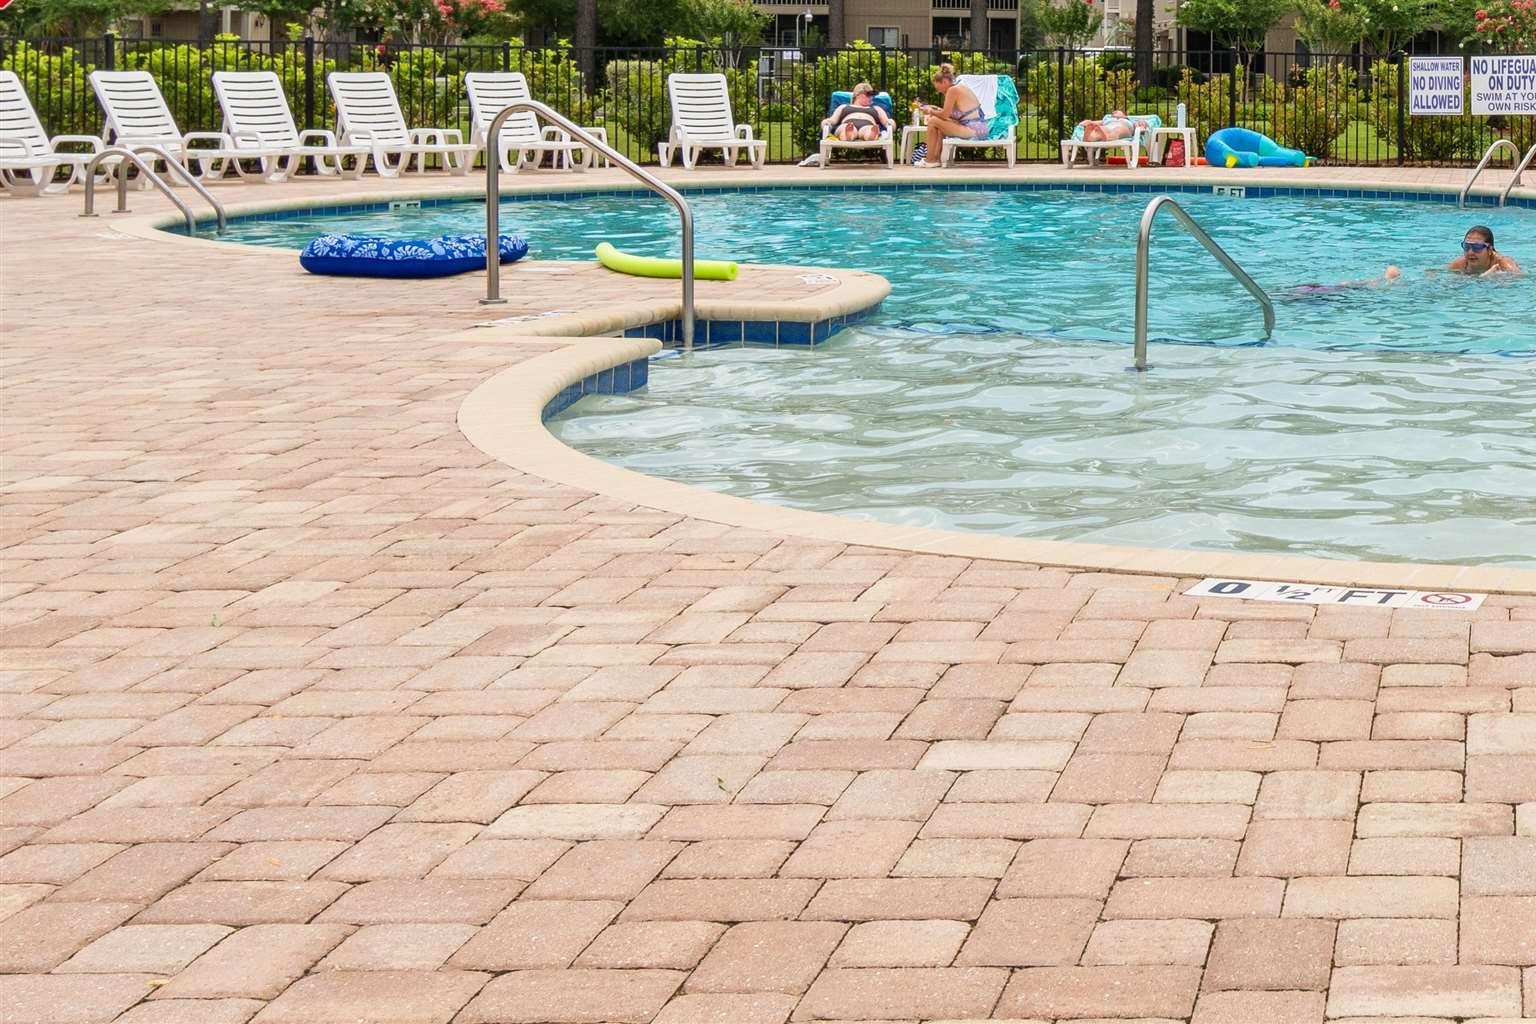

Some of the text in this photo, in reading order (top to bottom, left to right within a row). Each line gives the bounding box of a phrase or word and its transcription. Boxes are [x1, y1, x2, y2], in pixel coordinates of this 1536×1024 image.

[1413, 62, 1460, 71] SHALLOW WATER
[1473, 59, 1488, 74] NO
[1413, 76, 1460, 90] NO DIVING
[1489, 76, 1536, 90] ON DUTY
[1413, 95, 1460, 109] ALLOWED
[1477, 92, 1502, 102] SWIM
[1505, 92, 1518, 101] AT
[1488, 103, 1536, 112] OWN RISK
[1338, 590, 1407, 604] FT
